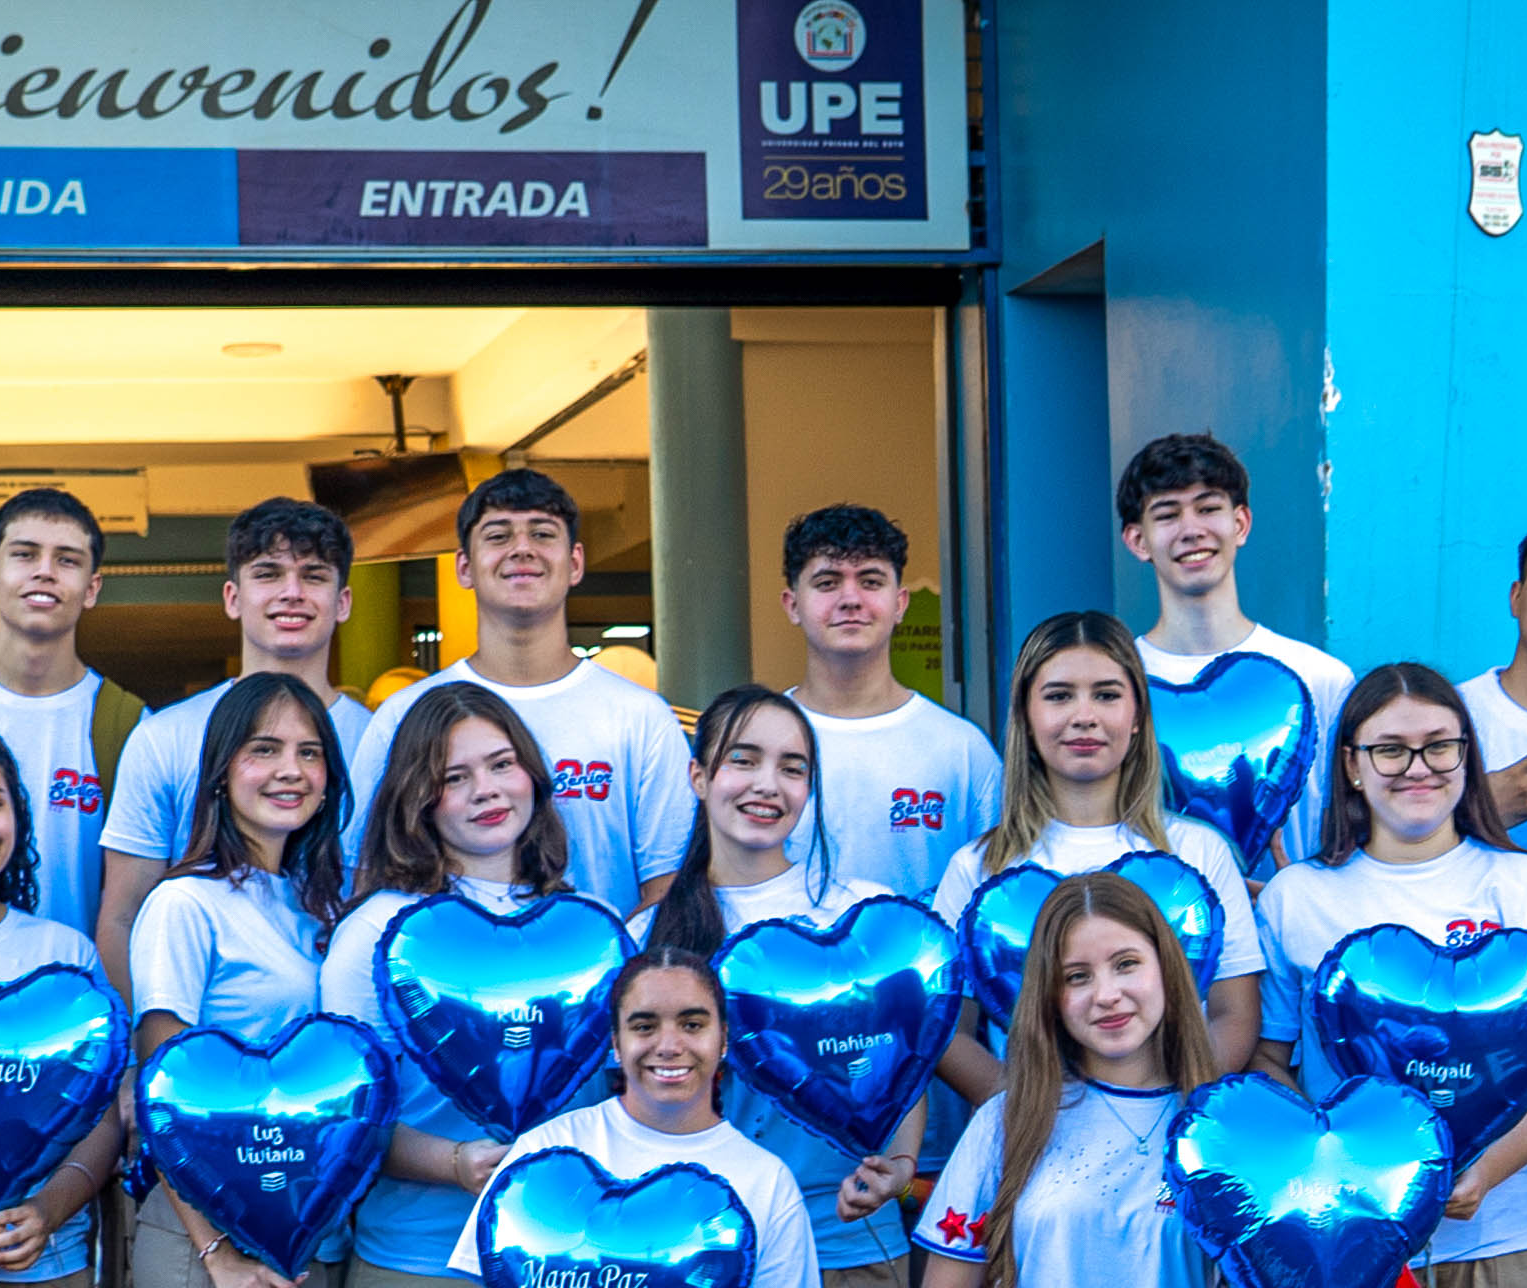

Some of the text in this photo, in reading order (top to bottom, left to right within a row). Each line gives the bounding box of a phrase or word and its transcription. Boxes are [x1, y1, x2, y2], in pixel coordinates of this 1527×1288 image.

[760, 81, 904, 135] UPE
[359, 180, 591, 219] ENTRADA
[552, 772, 612, 793] Senior
[817, 1032, 893, 1056] Mahiara
[1405, 1059, 1475, 1084] Abigail
[253, 1124, 284, 1145] Luz
[235, 1145, 306, 1165] Viviana
